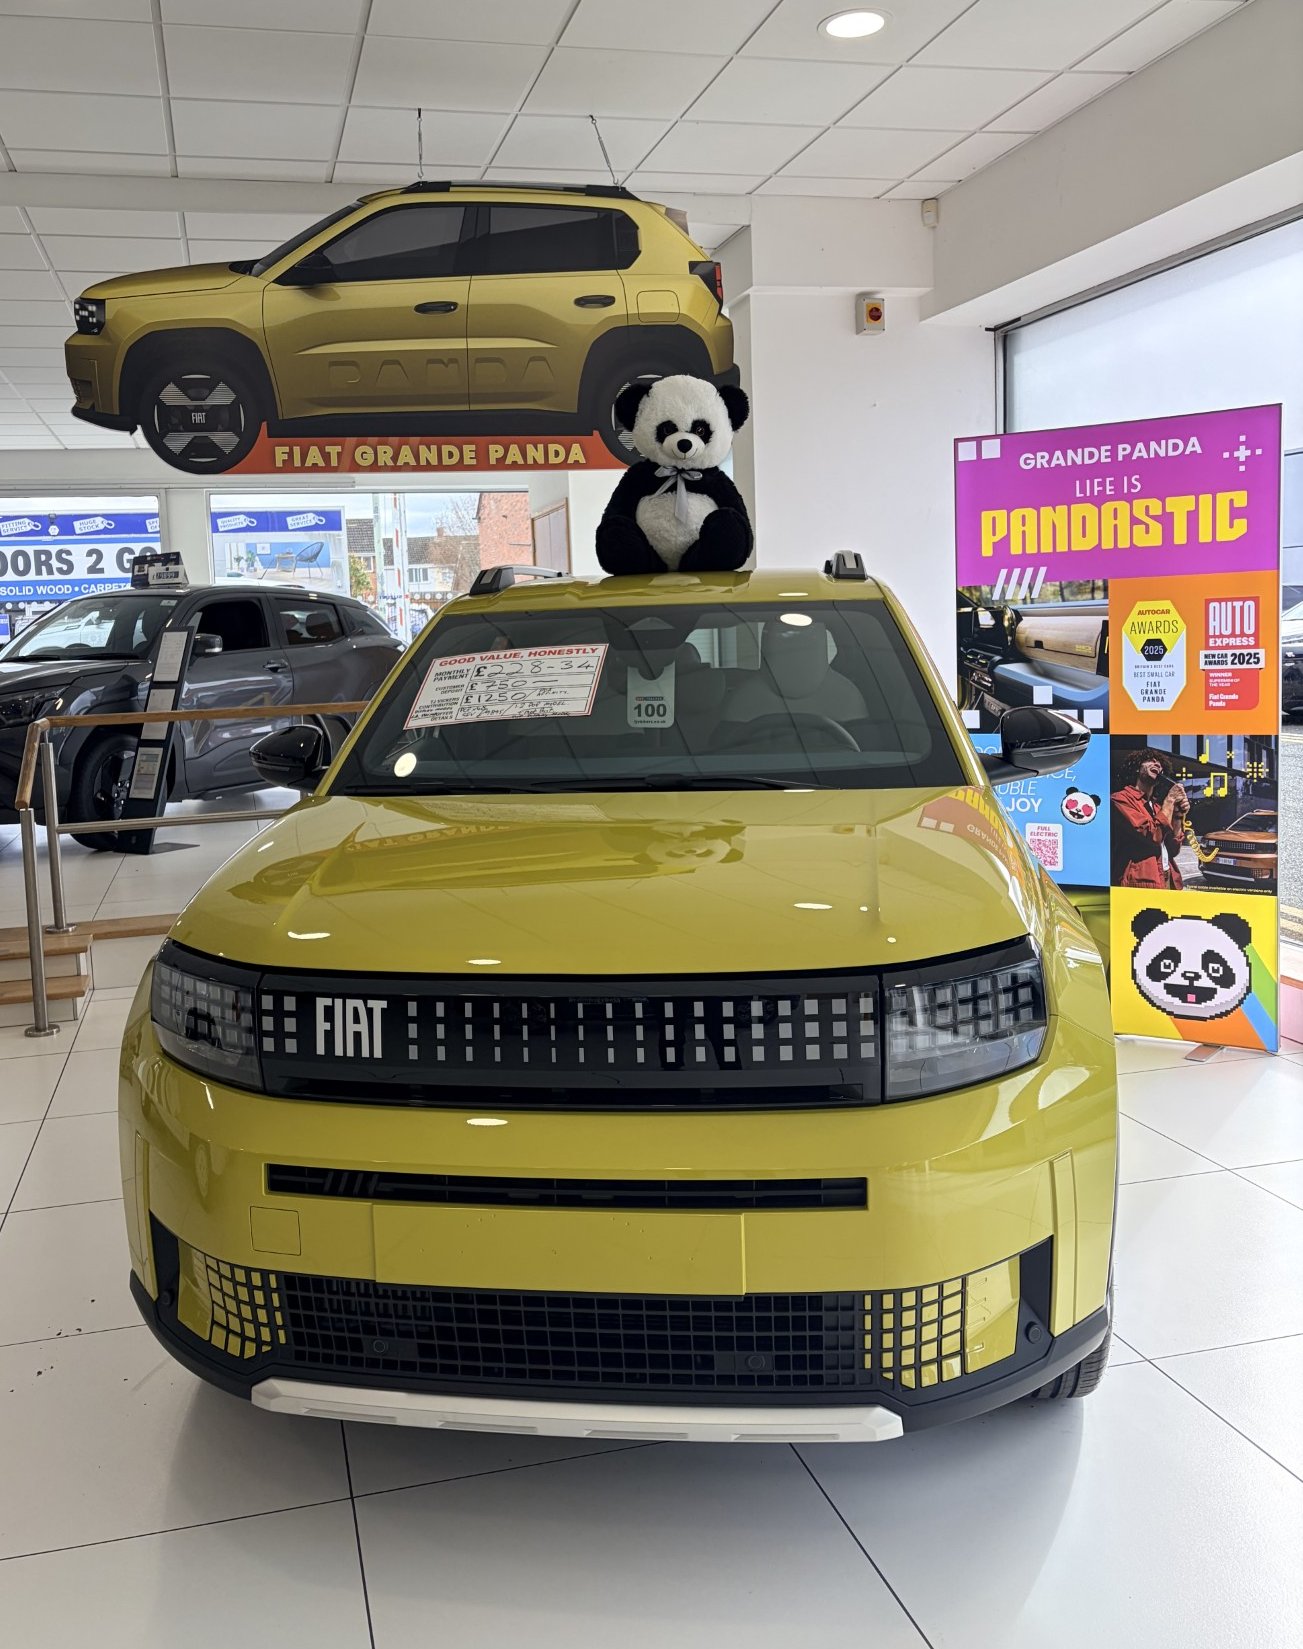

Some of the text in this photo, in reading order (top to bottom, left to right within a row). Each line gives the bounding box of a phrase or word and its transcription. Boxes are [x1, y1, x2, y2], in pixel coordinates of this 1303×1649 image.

[191, 412, 206, 424] FIAT
[274, 443, 586, 467] FIAT GRANDE PANDA
[1019, 436, 1203, 470] GRANDE PANDA
[1075, 475, 1141, 498] LIFE IS
[79, 523, 100, 532] STOCK
[981, 490, 1248, 557] PANDASTIC
[85, 548, 105, 575] 2
[0, 586, 34, 596] SOLID
[36, 585, 72, 595] WOOD
[1208, 600, 1256, 636] AUTO
[1129, 620, 1179, 635] AWARDS
[1209, 637, 1255, 647] EXPRESS
[439, 647, 599, 667] GOOD VALUE, HONESTLY
[1144, 645, 1164, 655] 2025
[1230, 652, 1261, 665] 2025
[433, 673, 469, 682] PAYMENT
[434, 668, 471, 677] MONTHLY
[633, 703, 667, 718] 100
[1006, 798, 1042, 812] JOY
[315, 997, 388, 1059] FIAT
